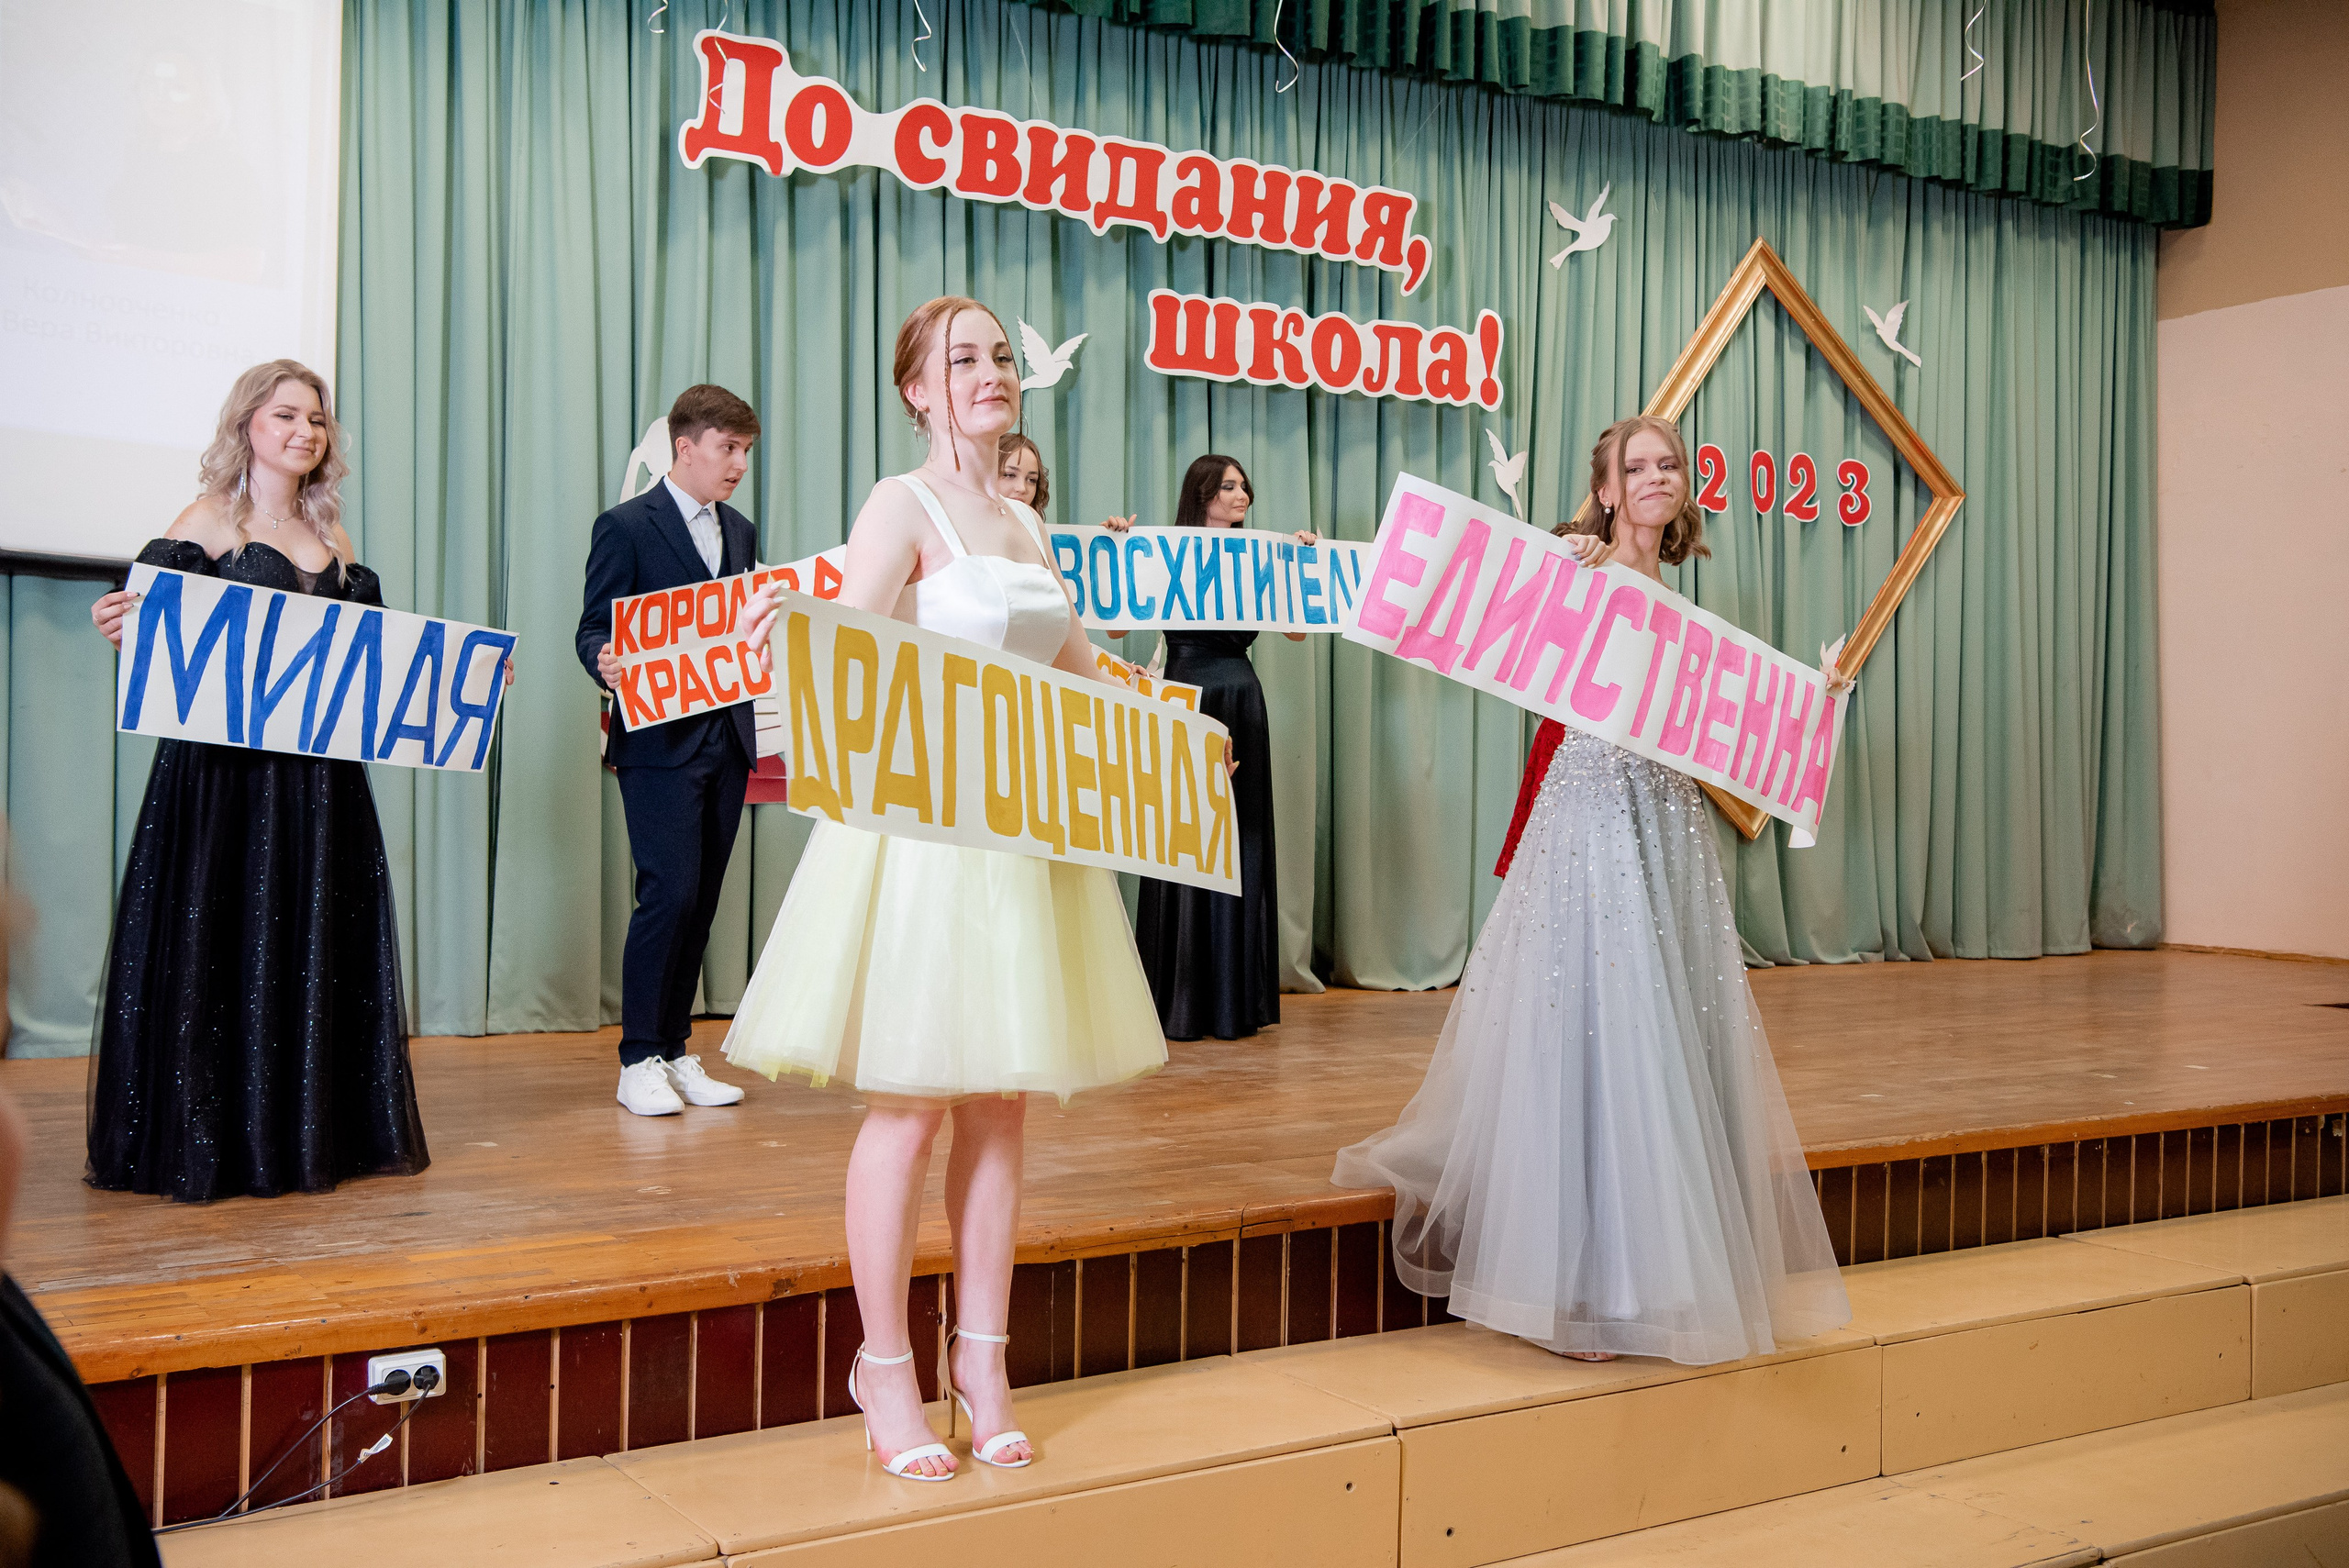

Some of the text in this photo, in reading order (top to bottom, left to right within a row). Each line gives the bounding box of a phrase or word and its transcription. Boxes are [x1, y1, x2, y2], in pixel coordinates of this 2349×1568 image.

[686, 36, 1428, 292] До свидания,
[1148, 295, 1499, 406] школа!
[121, 571, 517, 770] МИЛАЯ
[787, 611, 1233, 879] ДРАГОЦЕННАЯ
